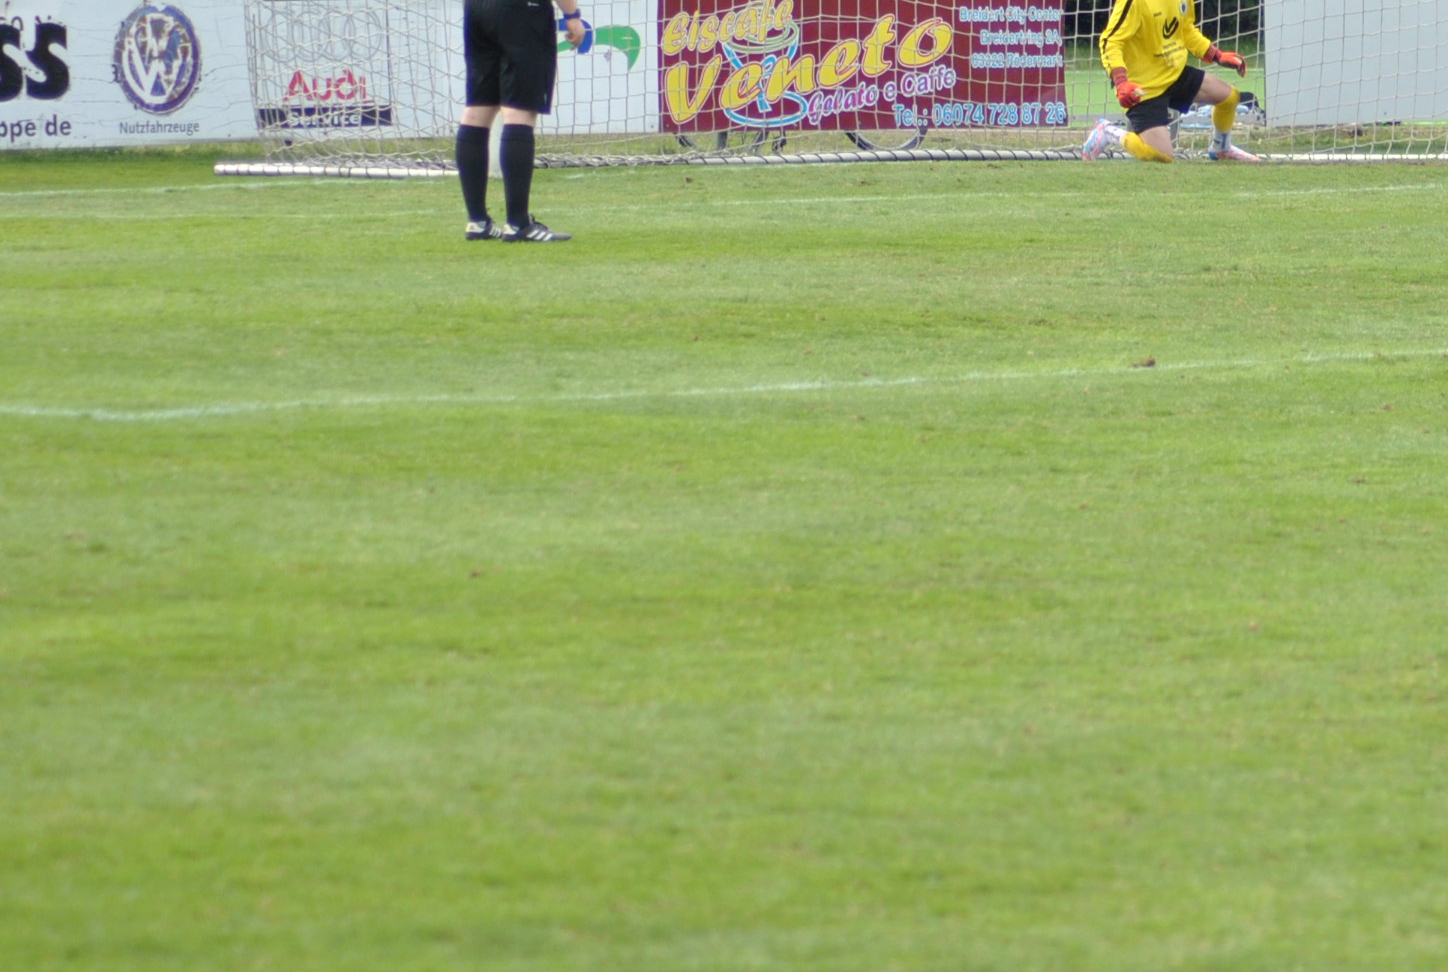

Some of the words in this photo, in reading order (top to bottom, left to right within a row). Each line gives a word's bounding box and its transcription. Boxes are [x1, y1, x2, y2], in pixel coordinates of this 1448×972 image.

[959, 6, 1005, 22] Breidert
[1006, 6, 1026, 25] City
[665, 15, 953, 124] Veneto
[283, 69, 367, 102] Audi
[808, 86, 878, 124] Gelato
[883, 81, 897, 101] e
[933, 103, 984, 126] 06074
[988, 102, 1018, 125] 728
[1022, 103, 1041, 124] 87
[1045, 102, 1066, 124] 26
[119, 121, 199, 136] Nutzfahrzeuge
[288, 110, 361, 126] Service
